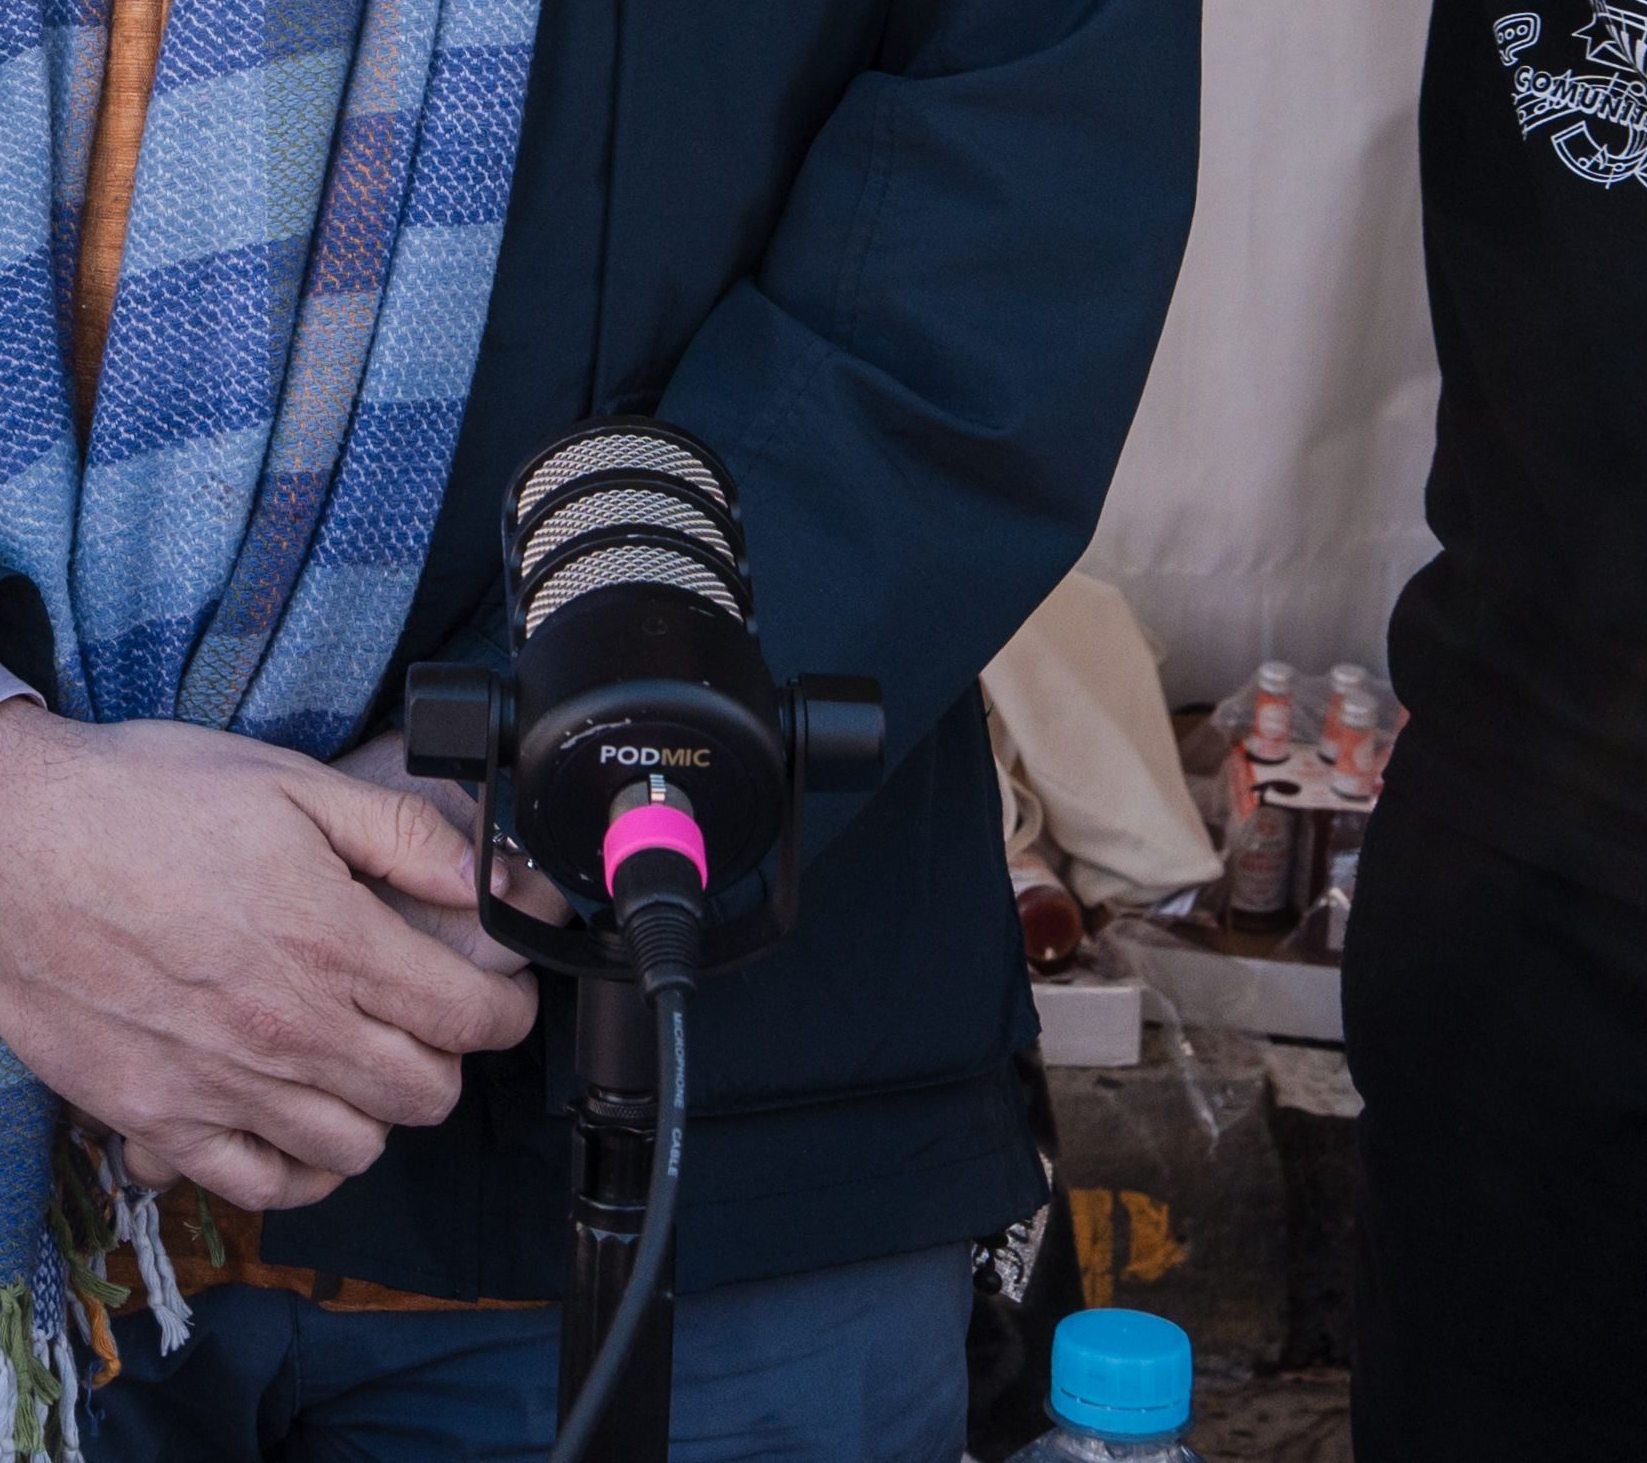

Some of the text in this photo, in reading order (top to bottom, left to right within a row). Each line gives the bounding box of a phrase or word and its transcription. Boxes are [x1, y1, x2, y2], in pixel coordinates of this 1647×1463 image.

[599, 744, 712, 768] PODMIC
[673, 1011, 686, 1110] MICROPHONE
[667, 1127, 683, 1178] CABLE
